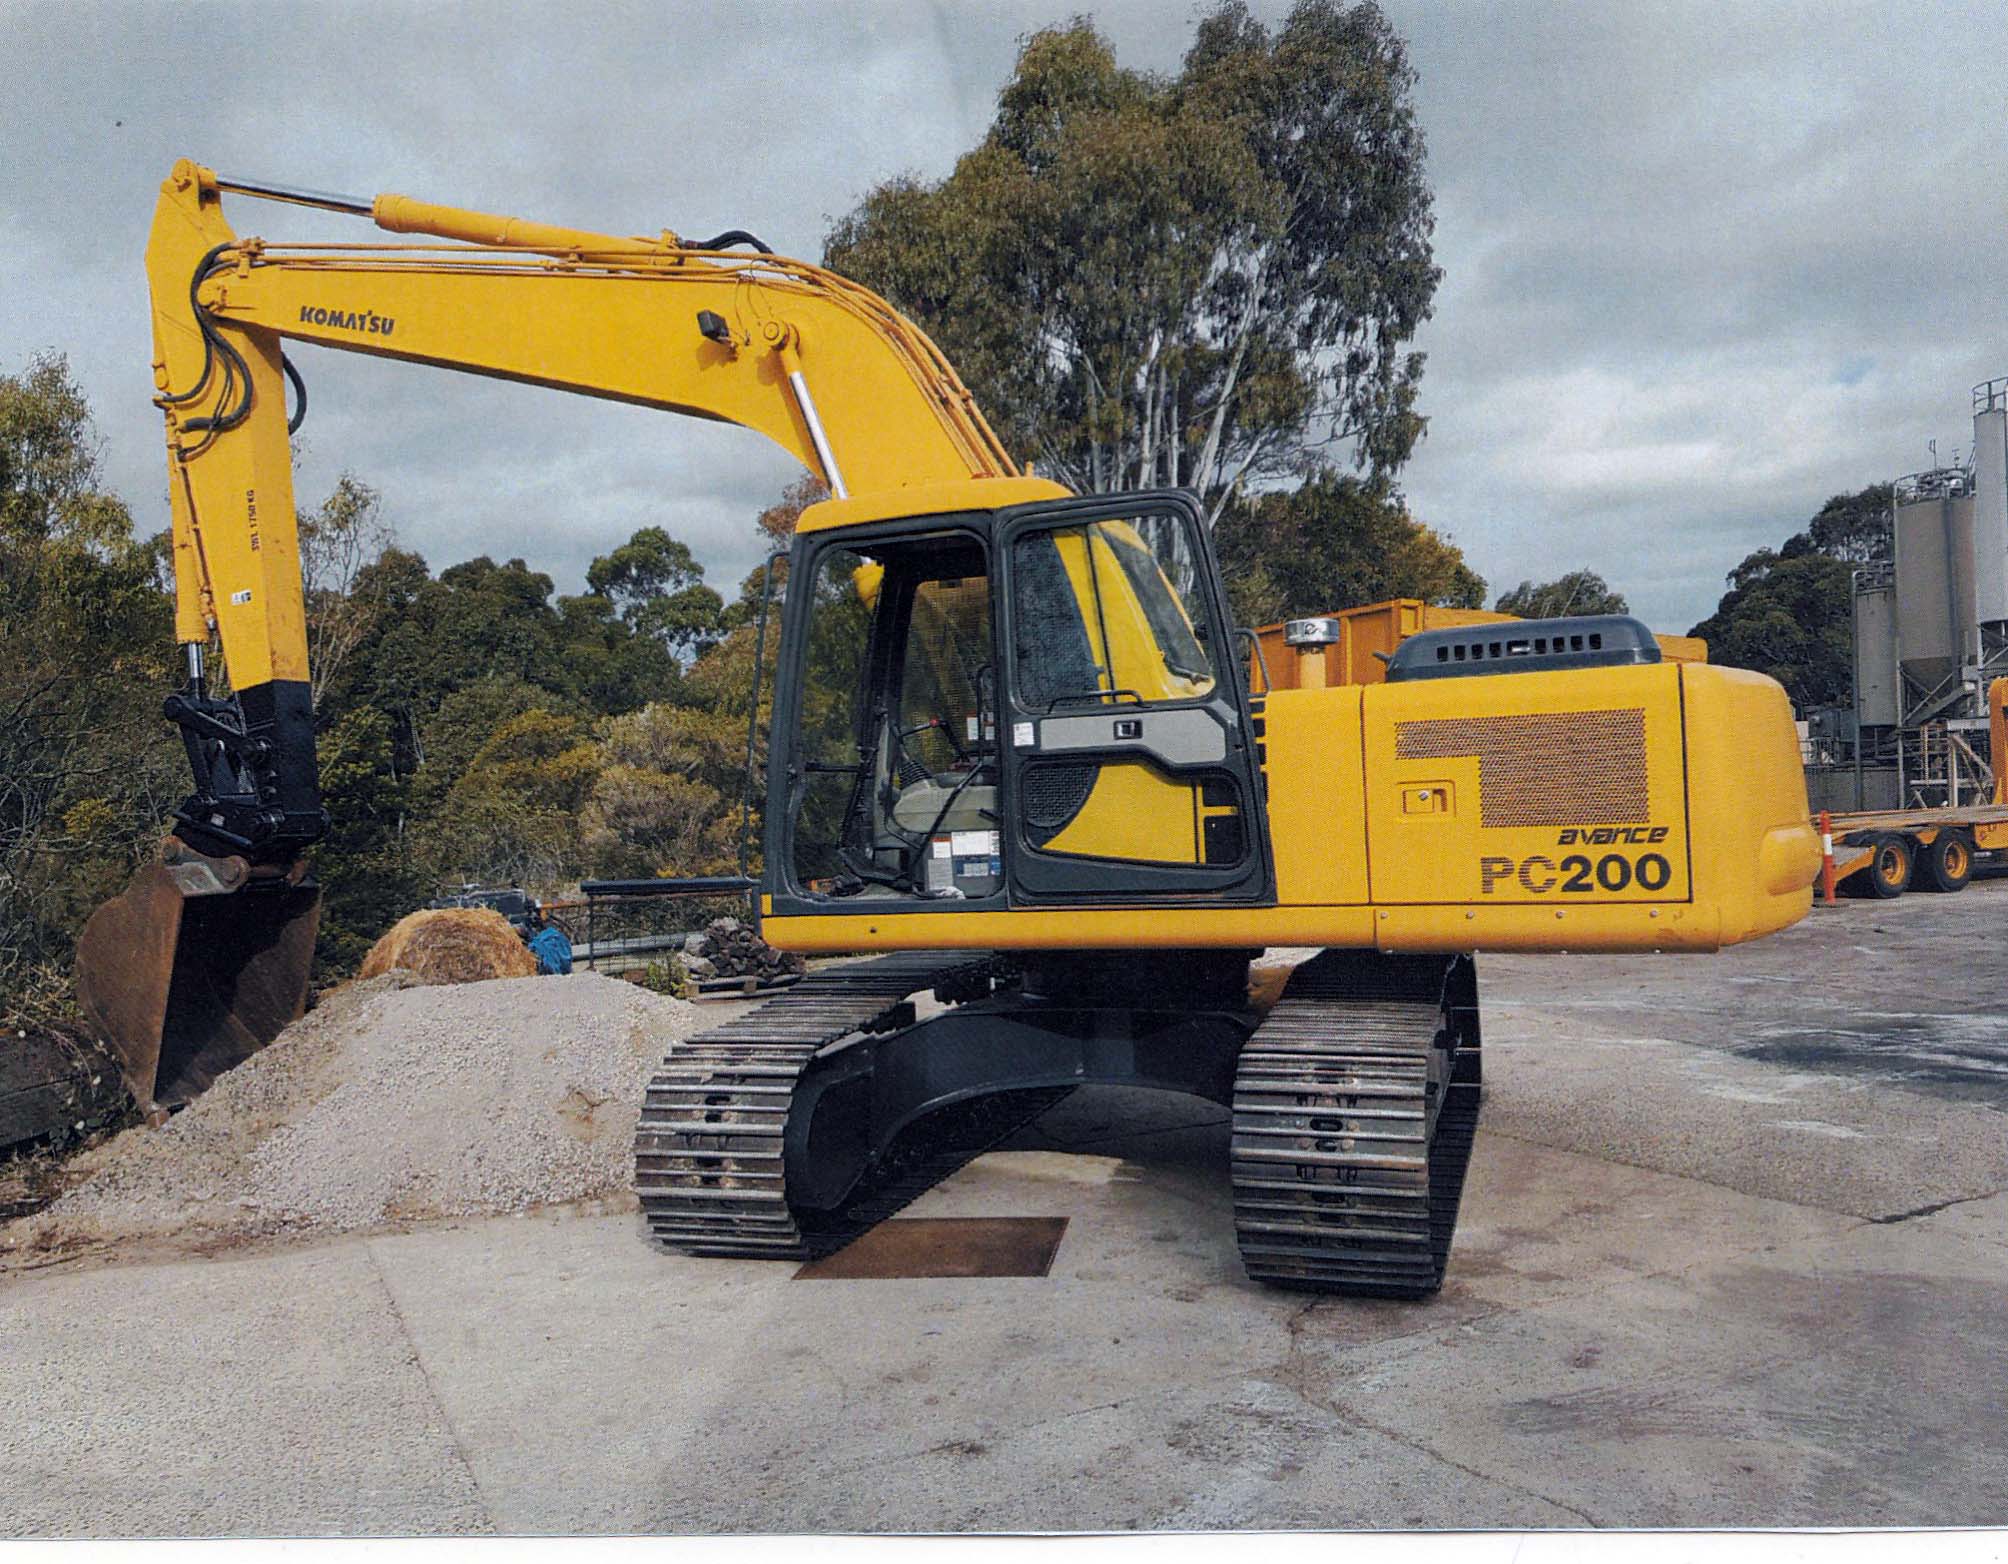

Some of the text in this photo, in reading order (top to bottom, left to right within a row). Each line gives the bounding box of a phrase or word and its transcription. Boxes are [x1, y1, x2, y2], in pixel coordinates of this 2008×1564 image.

[300, 305, 395, 335] KOMATSU
[1558, 827, 1669, 845] avance
[1480, 853, 1671, 893] PC200
